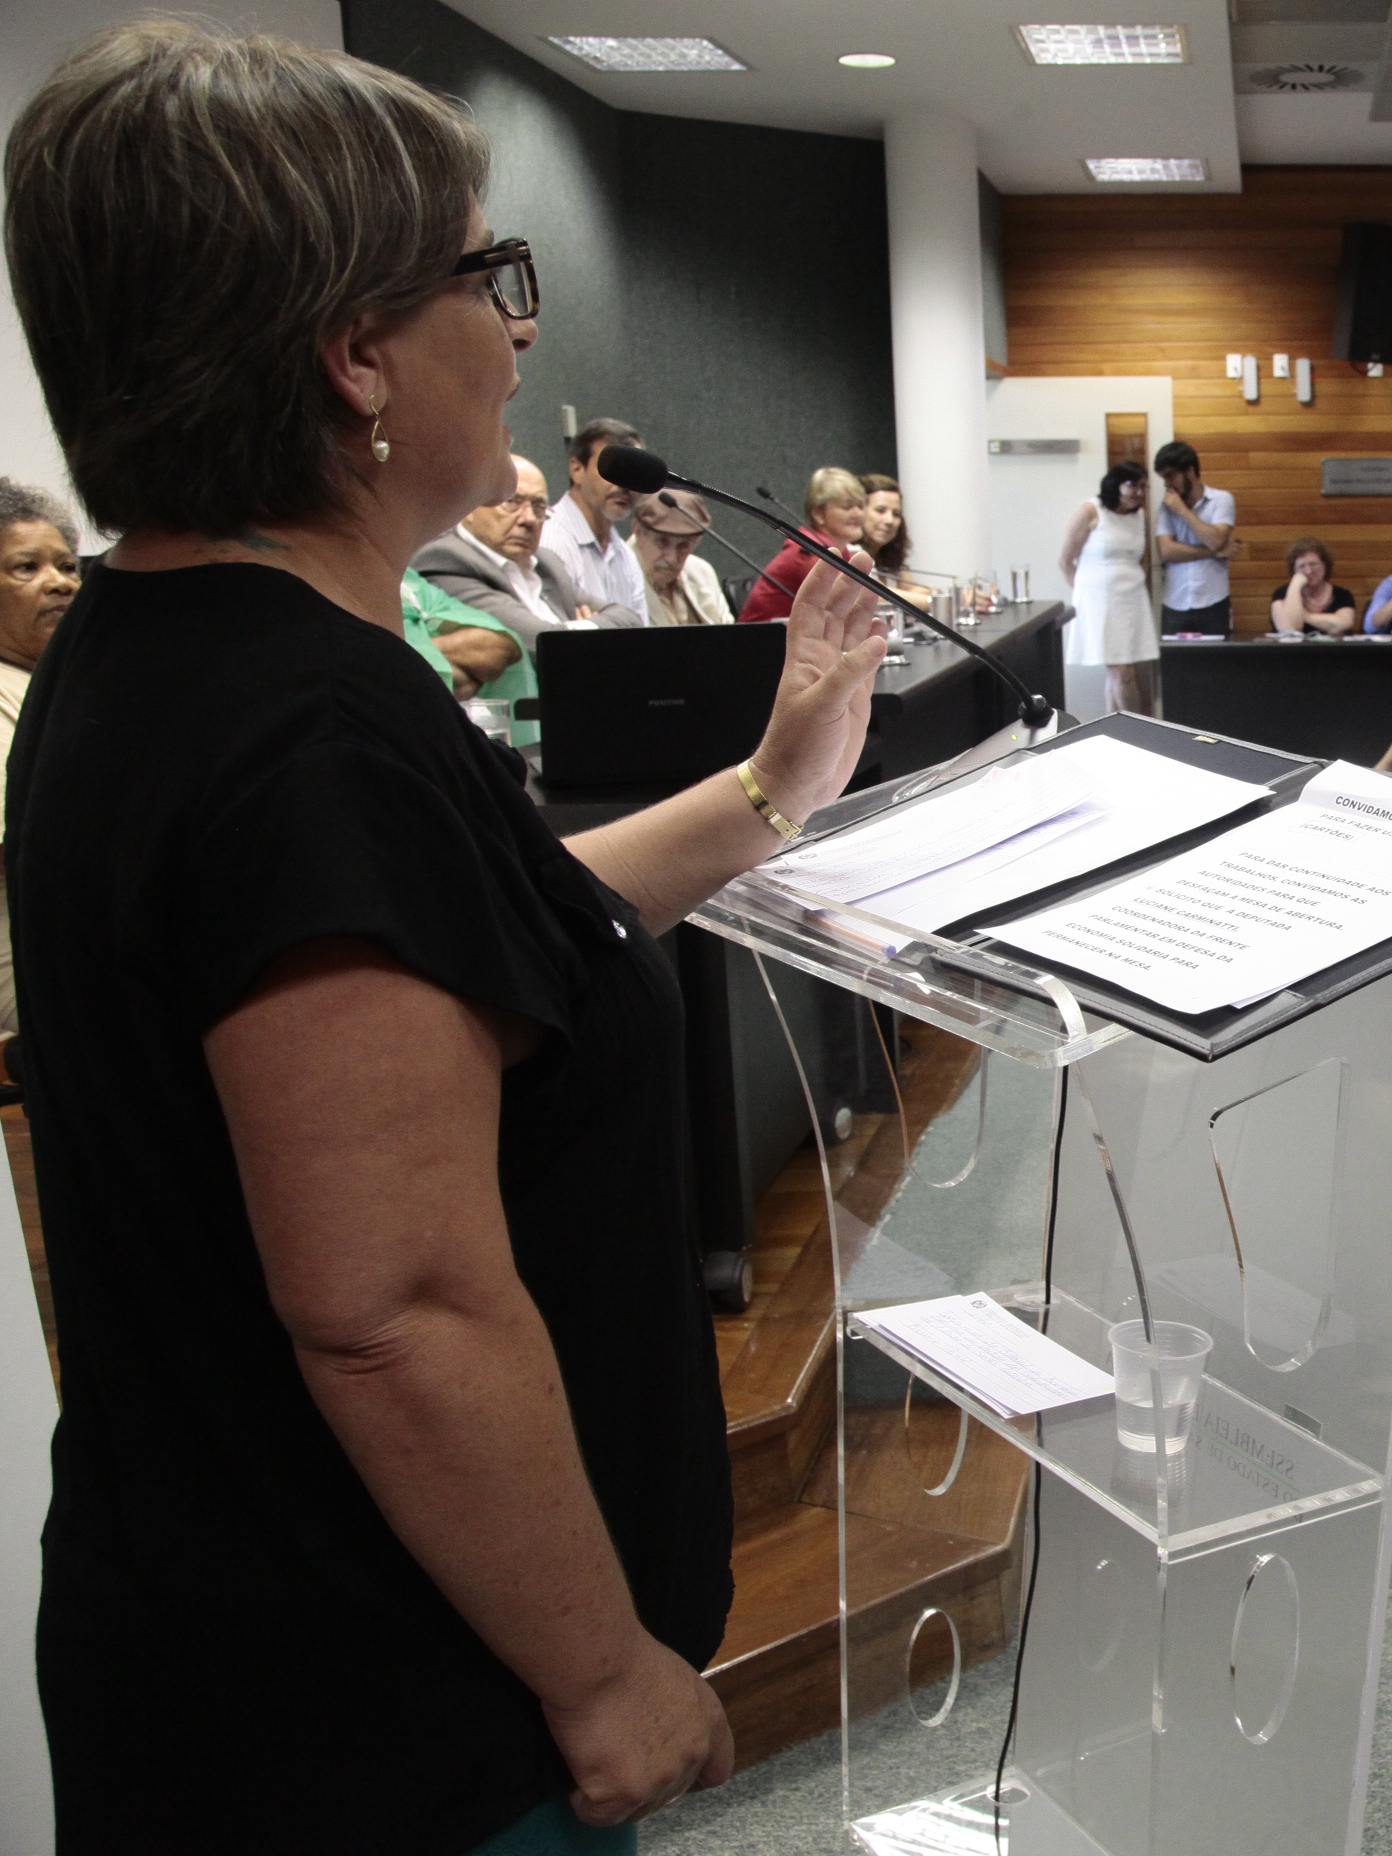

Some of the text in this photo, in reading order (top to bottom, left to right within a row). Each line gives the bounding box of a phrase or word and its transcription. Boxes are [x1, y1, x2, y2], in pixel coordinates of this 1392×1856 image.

[1320, 813, 1347, 824] PARA
[1347, 820, 1380, 834] FAZER
[1197, 870, 1322, 907] AUTORIDADES PARA QUE
[1219, 860, 1368, 905] TRABALHOS, CONVIDAMOS AS
[1238, 852, 1392, 896] PARA DAR CONTINUIDADE AOS
[1132, 897, 1179, 913] LUCIANE
[1155, 888, 1202, 904] SOLICITO
[1201, 901, 1224, 911] QUE
[1235, 911, 1293, 931] DEPUTADA
[1176, 879, 1231, 898] DESFAÇAM
[1238, 897, 1268, 908] MESA
[1267, 905, 1286, 913] DE
[1041, 930, 1106, 954] PERMANECER
[1105, 951, 1121, 960] NA
[1065, 922, 1117, 942] ECONOMIA
[1168, 956, 1200, 970] PARA
[1088, 914, 1234, 964] PARLAMENTAR EM DEFESA DA
[1111, 905, 1250, 951] COORDENADORA DA FRENTE
